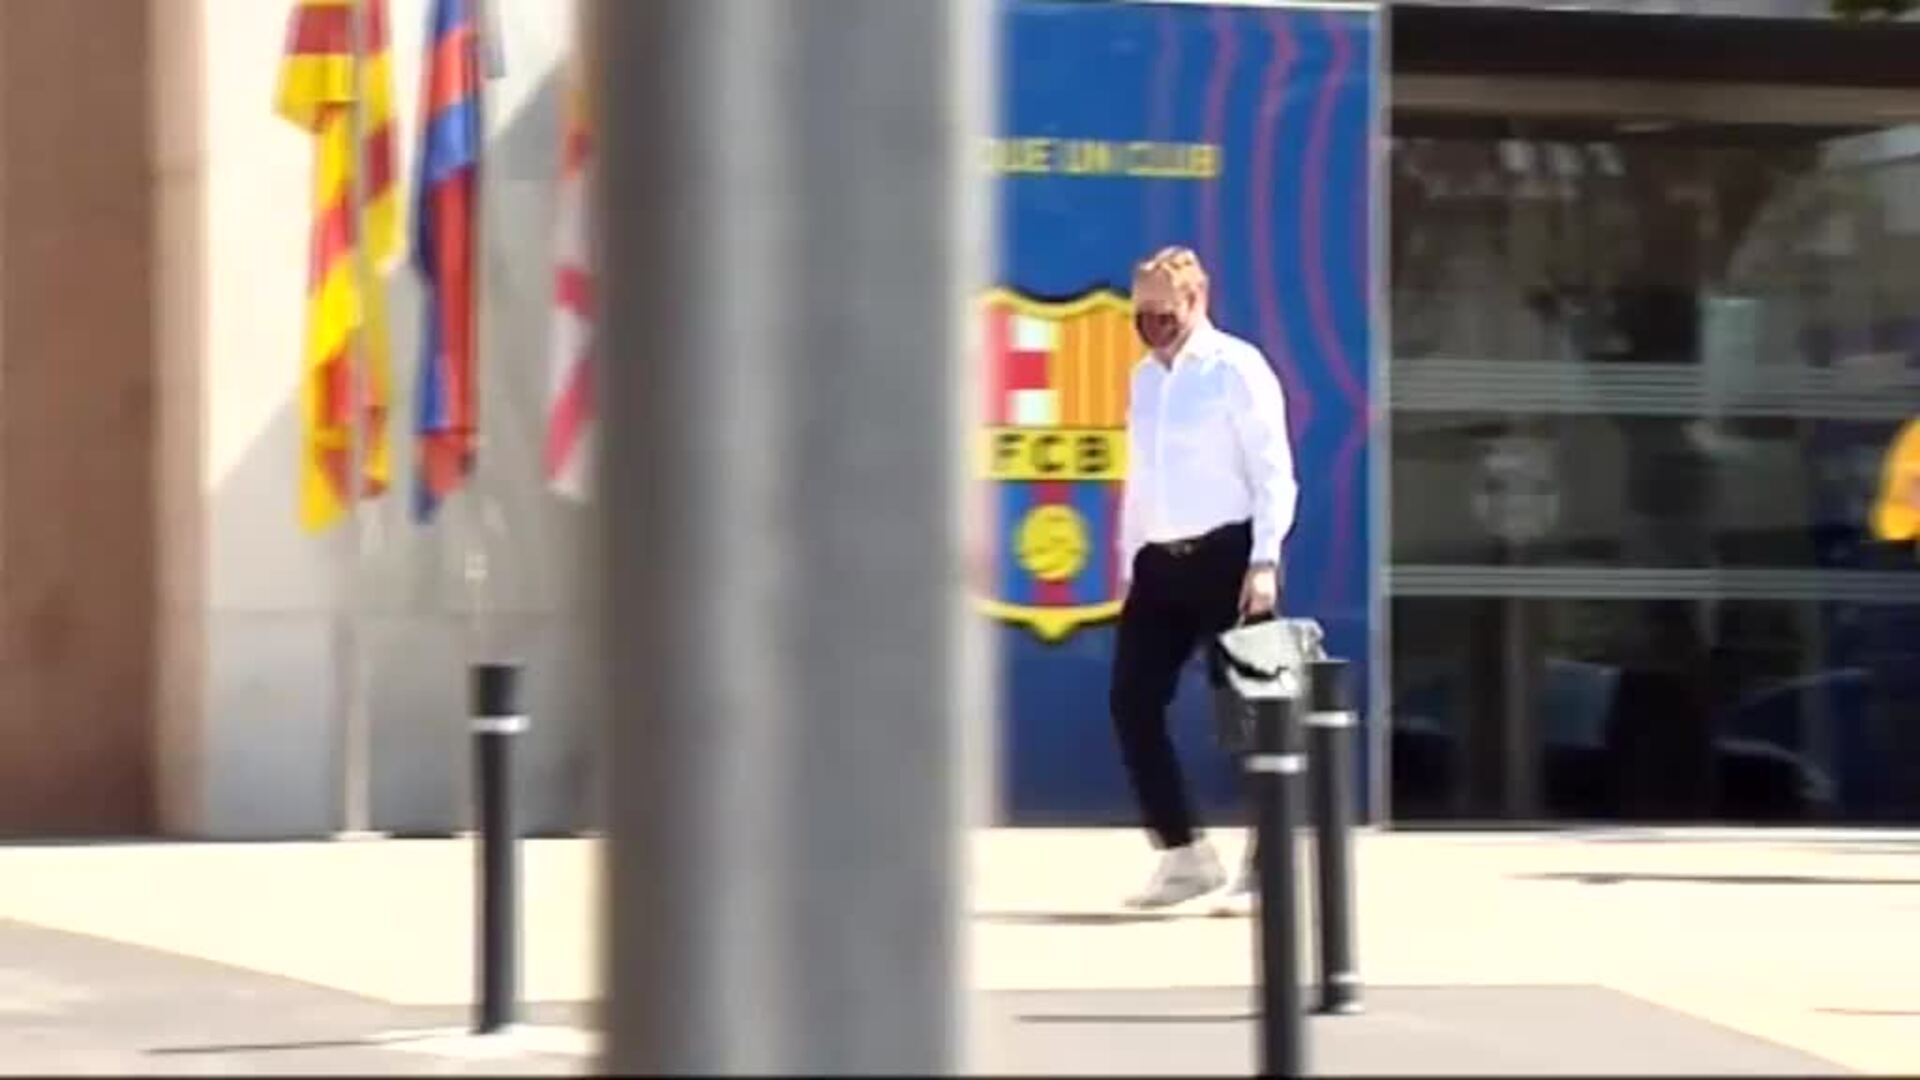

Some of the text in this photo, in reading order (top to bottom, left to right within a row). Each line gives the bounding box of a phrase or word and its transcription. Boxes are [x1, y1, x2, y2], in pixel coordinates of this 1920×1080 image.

[1057, 139, 1112, 175] UN
[1121, 141, 1221, 178] CLUB
[994, 432, 1113, 475] FCB
